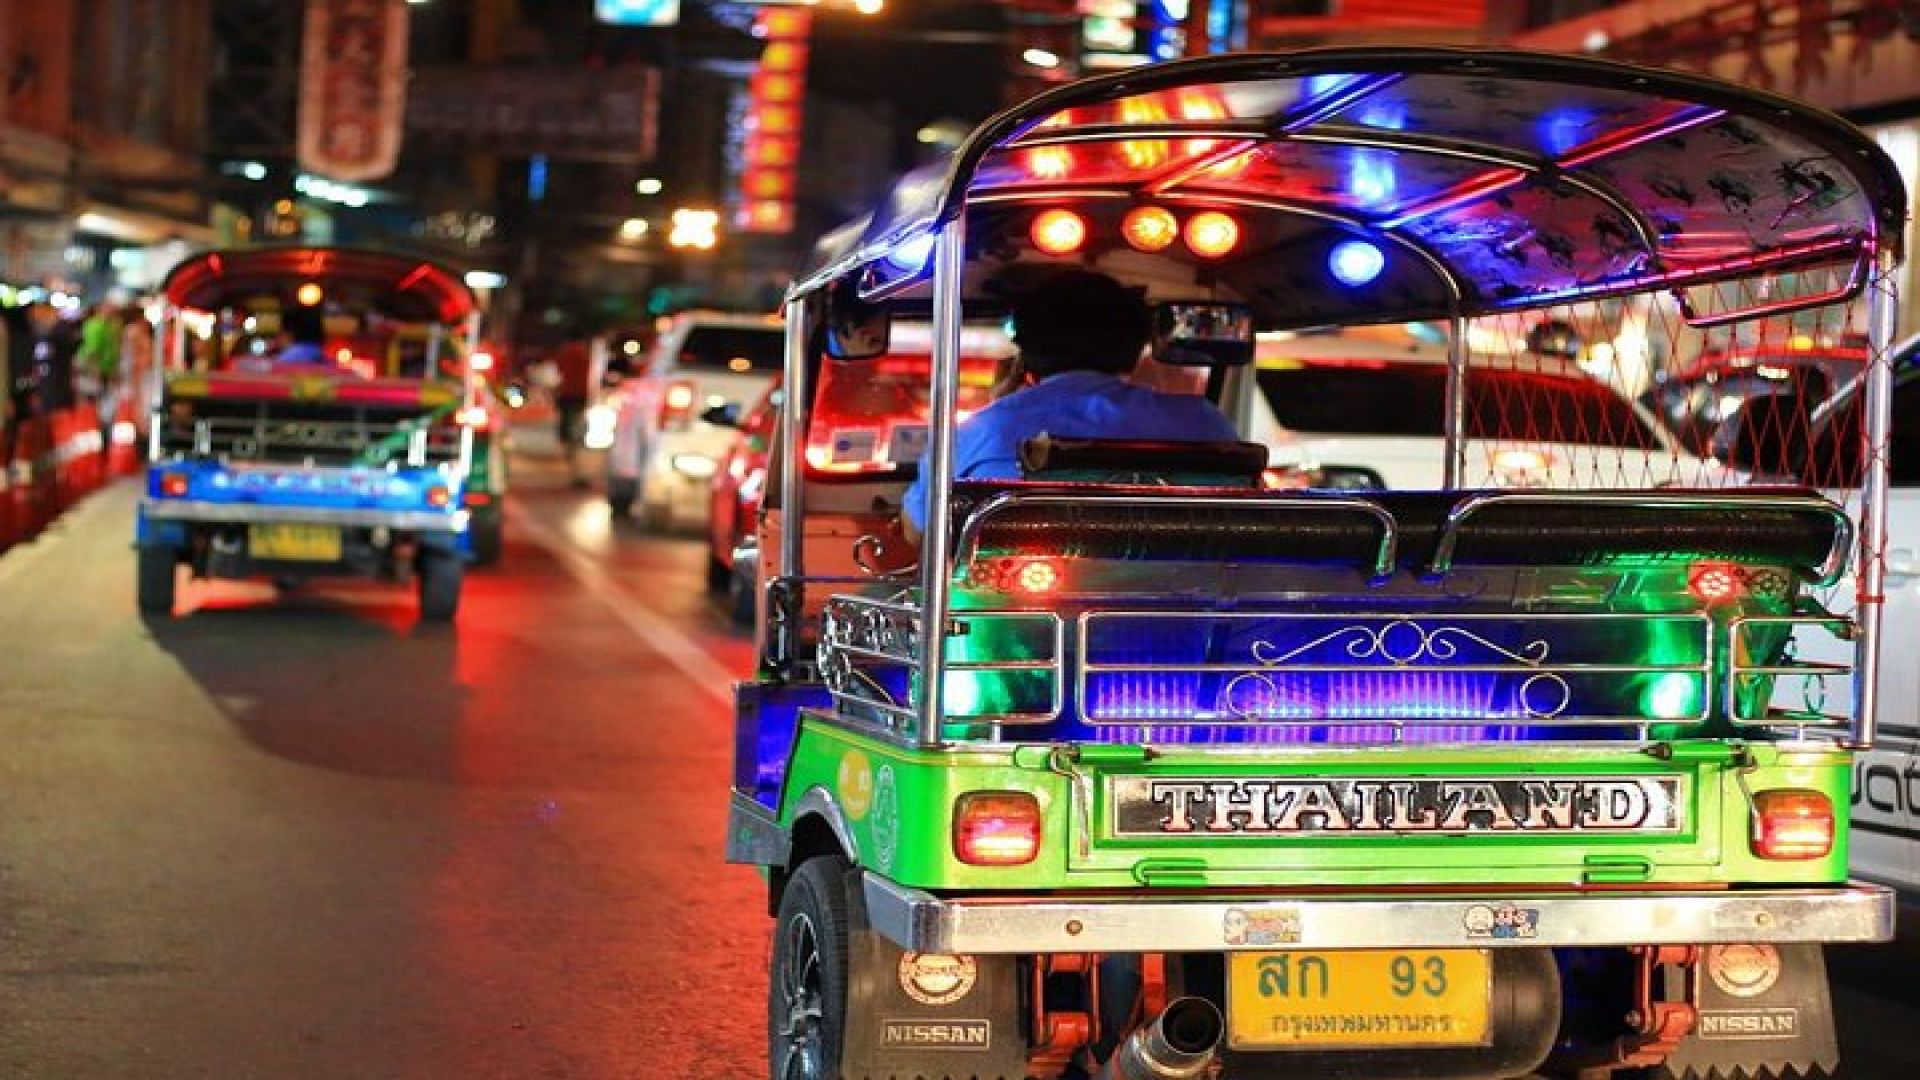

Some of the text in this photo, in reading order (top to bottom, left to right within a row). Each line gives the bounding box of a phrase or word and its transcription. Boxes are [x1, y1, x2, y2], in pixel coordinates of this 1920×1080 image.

[1151, 780, 1651, 832] THAILAND
[1257, 953, 1447, 998] สก 93
[887, 1025, 985, 1043] NISSAN
[1703, 1016, 1793, 1032] NISSAN
